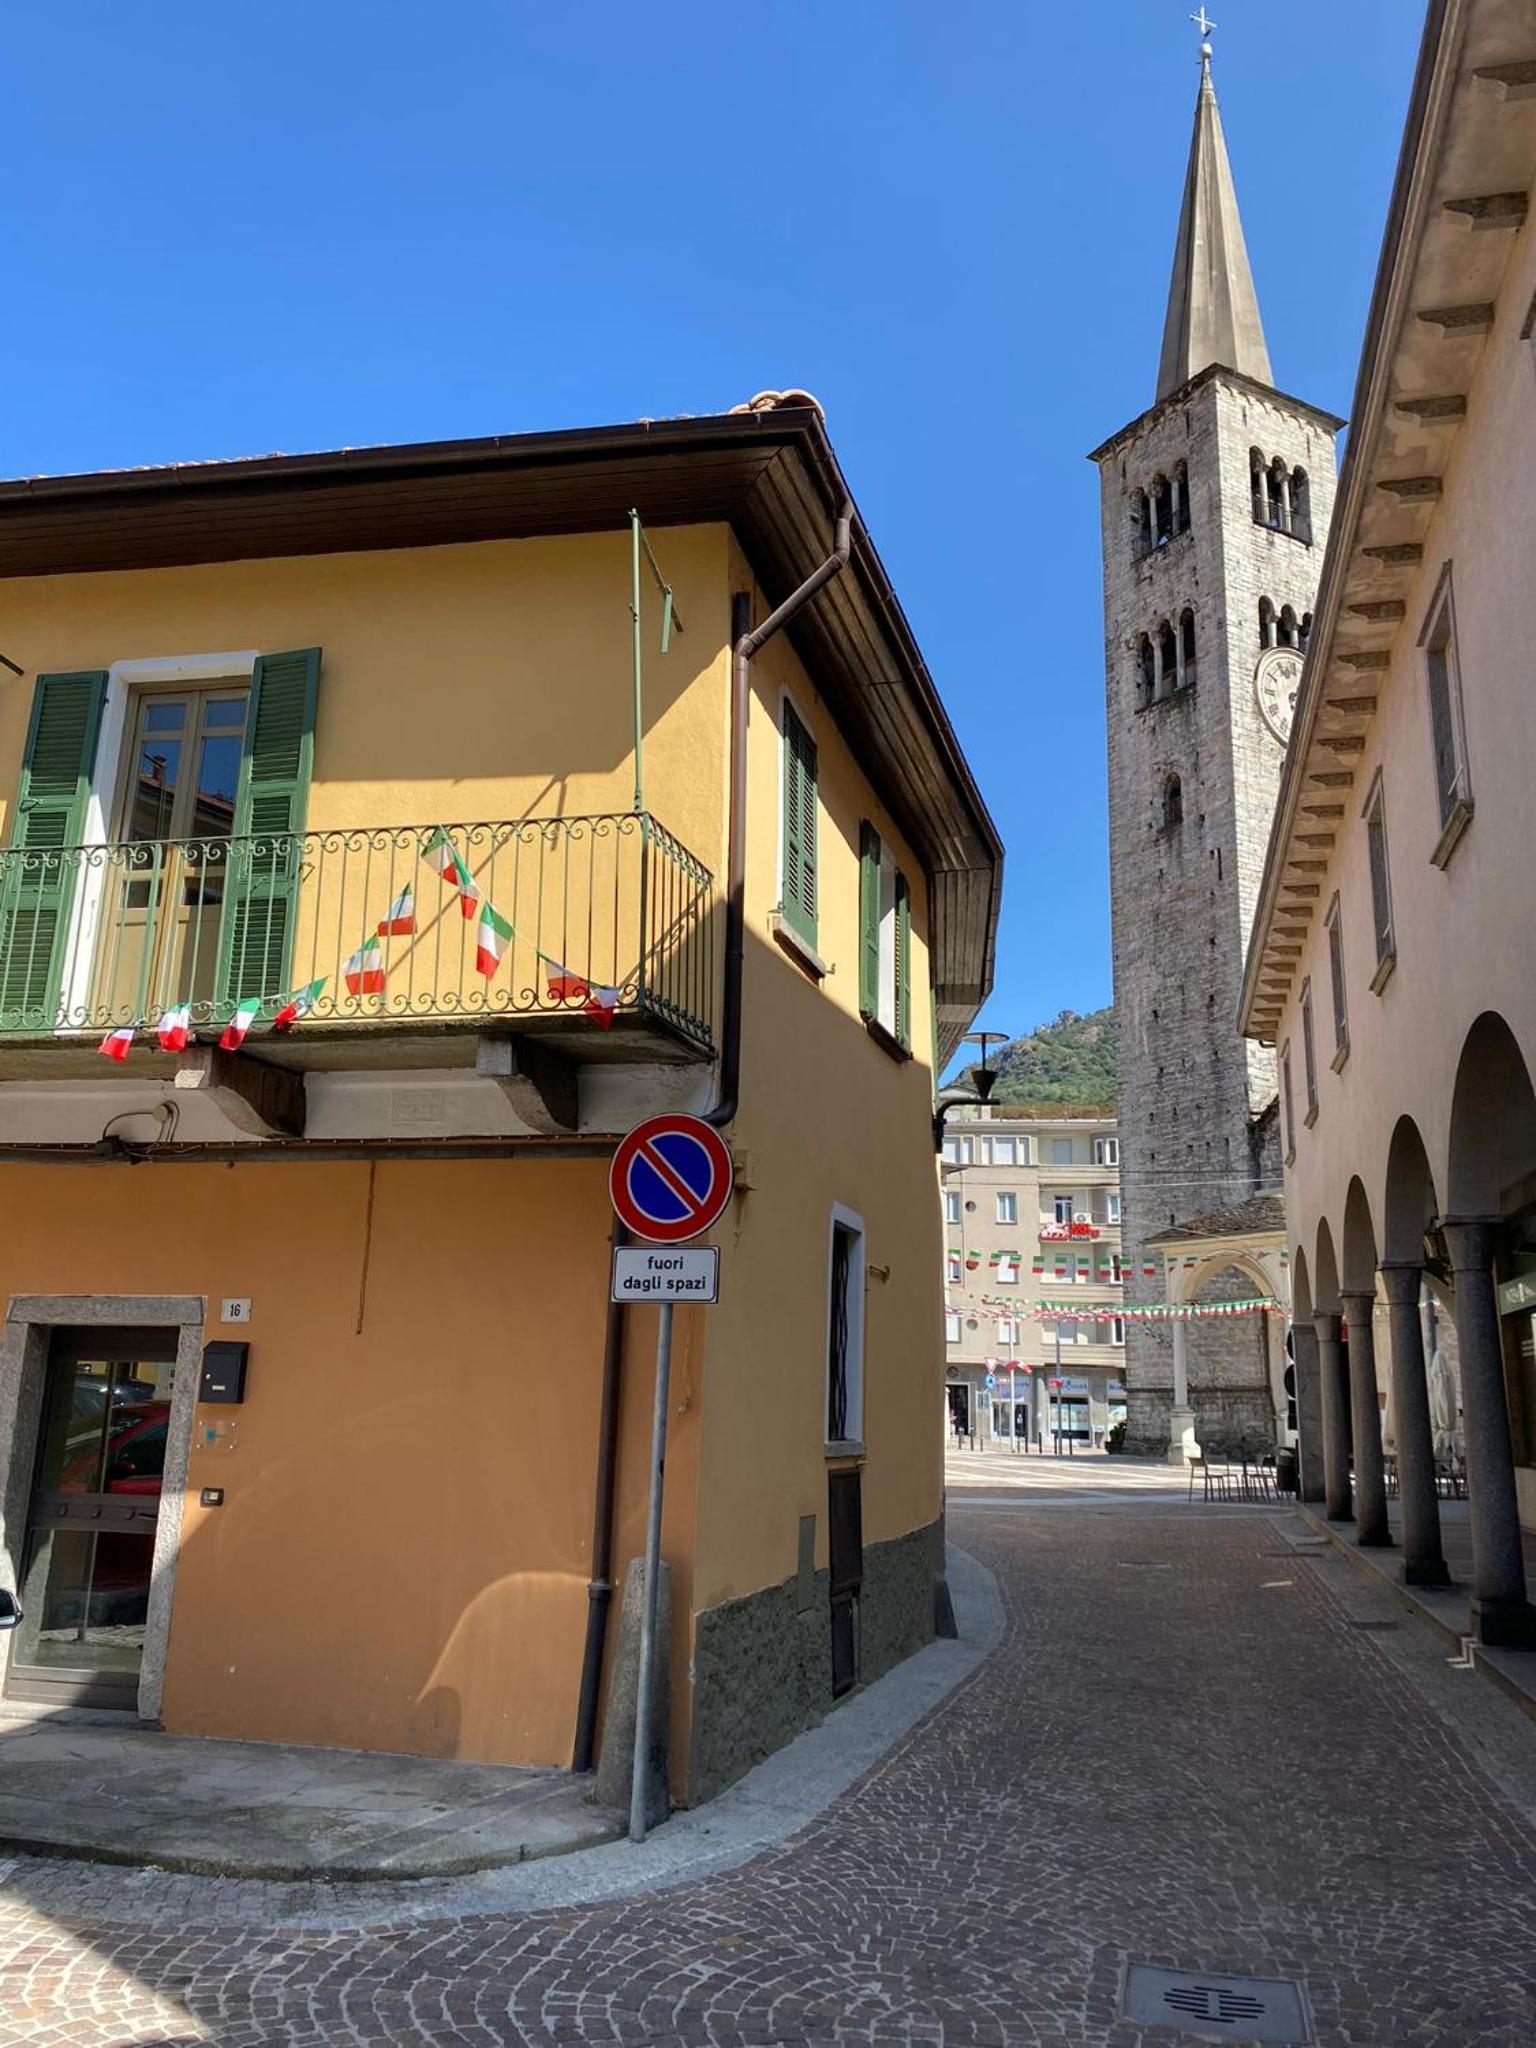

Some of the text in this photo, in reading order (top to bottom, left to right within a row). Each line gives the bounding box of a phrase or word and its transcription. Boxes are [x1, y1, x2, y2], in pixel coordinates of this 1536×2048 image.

[648, 1256, 683, 1270] fuori
[623, 1276, 706, 1293] dagli spazi
[230, 1304, 241, 1317] 16
